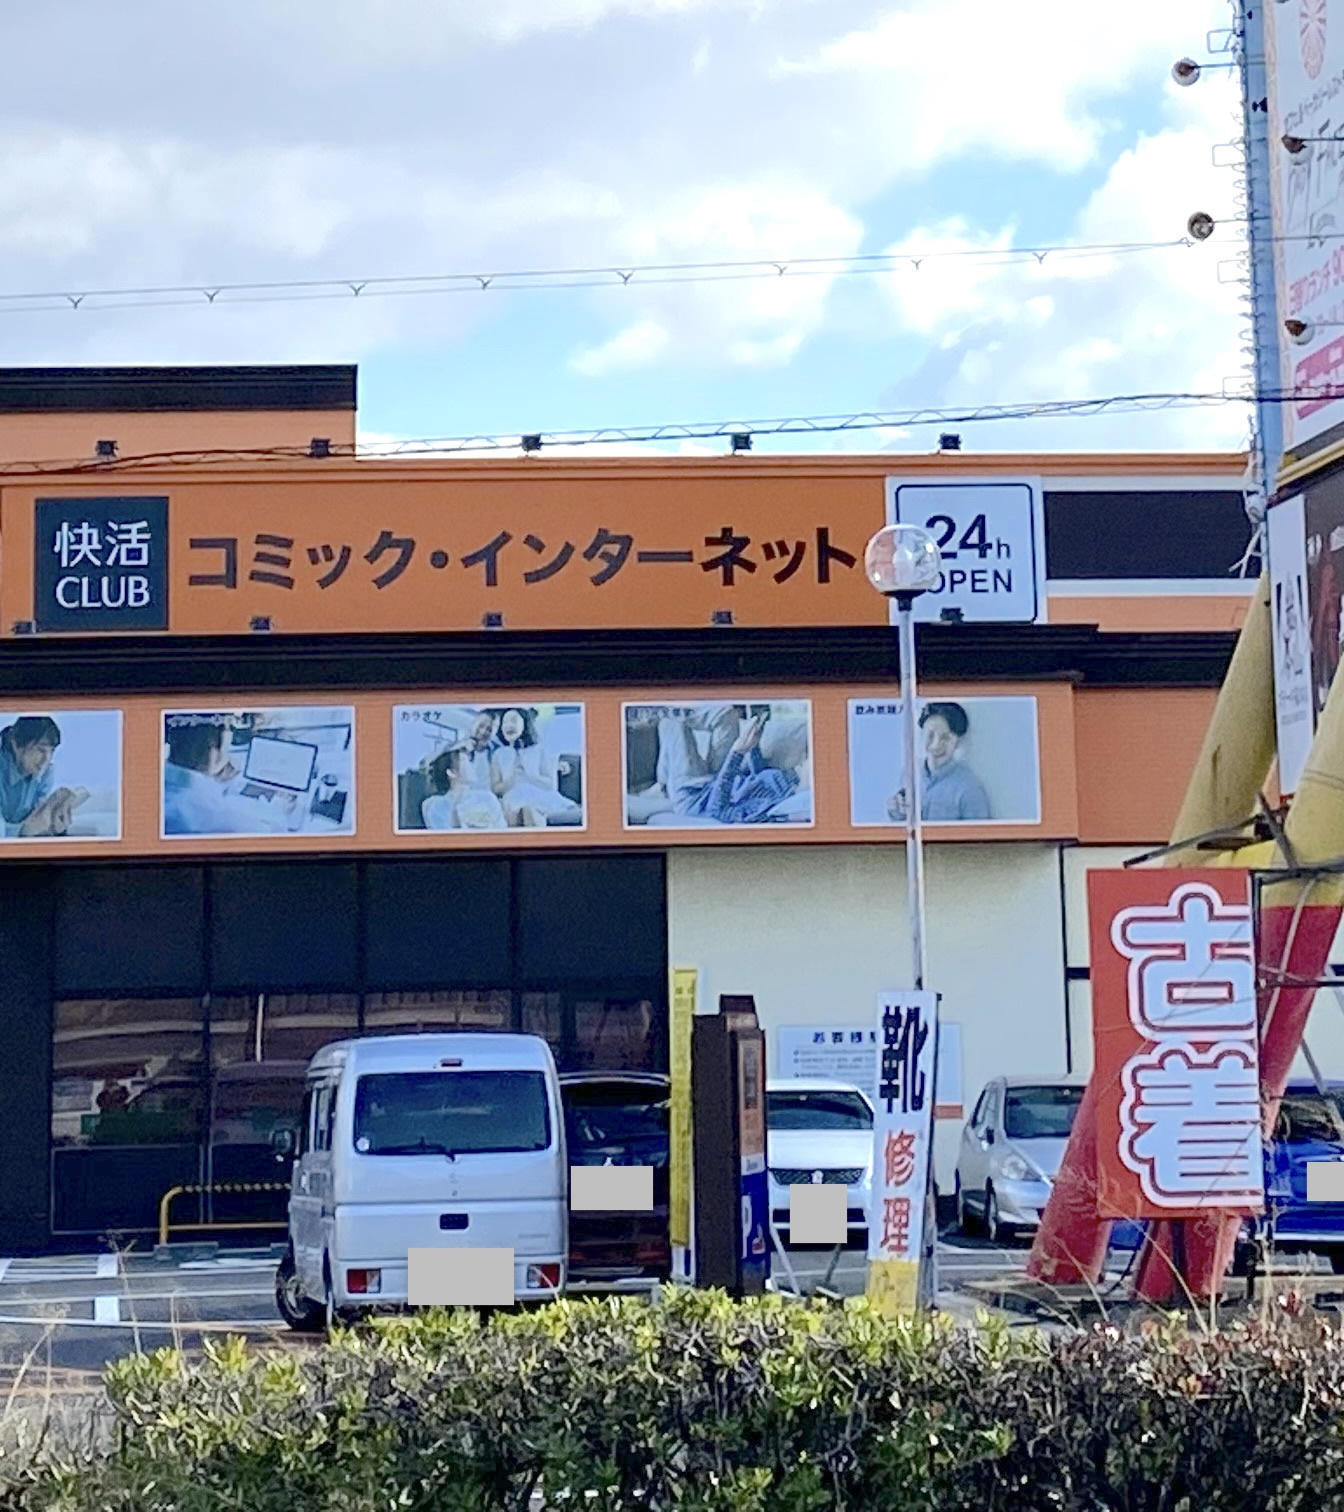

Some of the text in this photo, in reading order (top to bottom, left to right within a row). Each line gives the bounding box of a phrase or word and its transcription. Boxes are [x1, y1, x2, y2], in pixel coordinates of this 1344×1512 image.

[54, 520, 152, 567] 快活
[188, 527, 857, 590] コミック・インターネット
[925, 514, 1011, 560] 24h
[55, 575, 151, 608] CLUB
[928, 568, 1012, 593] OPEN
[1110, 881, 1264, 1208] 古着
